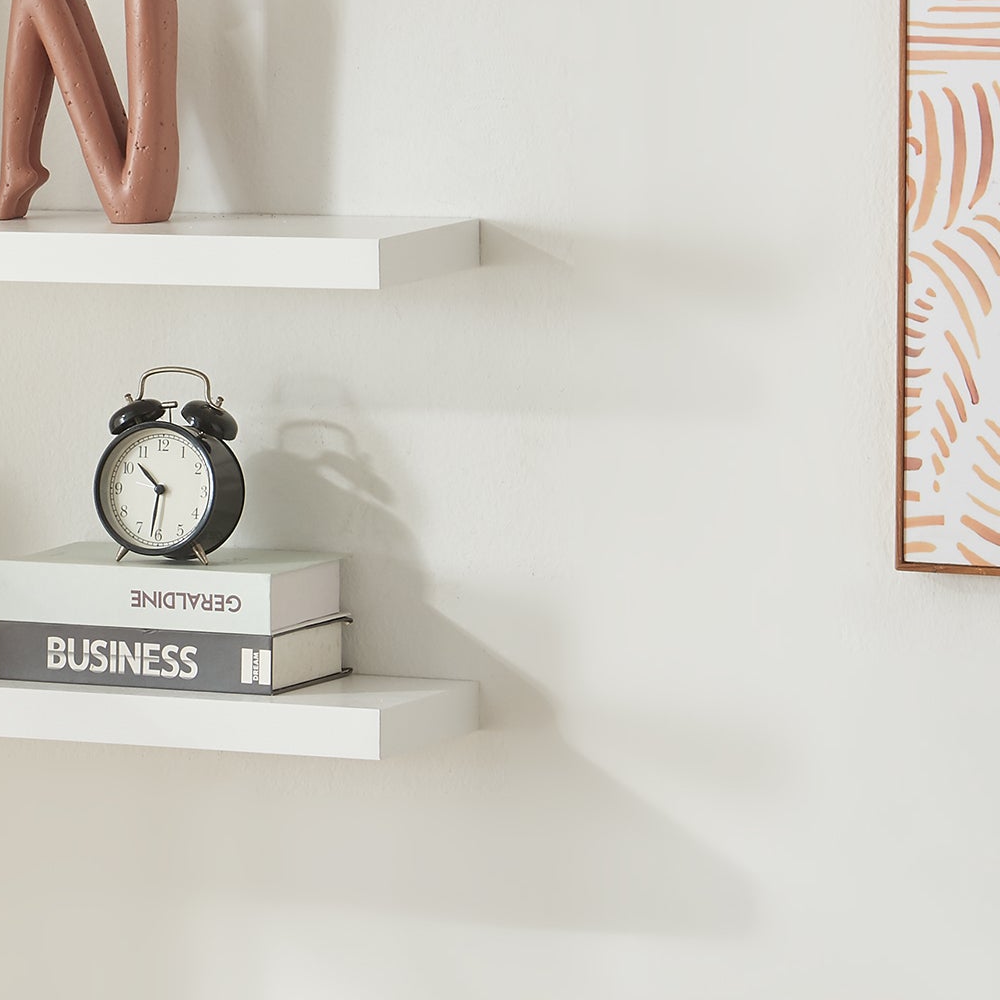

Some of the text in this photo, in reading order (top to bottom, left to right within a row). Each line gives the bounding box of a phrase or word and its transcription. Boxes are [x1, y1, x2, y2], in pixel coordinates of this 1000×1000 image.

[158, 439, 169, 451] 12
[139, 446, 148, 458] 11
[181, 446, 185, 458] 1
[123, 462, 134, 474] 10
[194, 462, 202, 475] 2
[115, 482, 123, 495] 9
[200, 486, 207, 498] 3
[120, 505, 128, 517] 8
[191, 507, 199, 519] 4
[136, 522, 143, 533] 7
[176, 524, 184, 537] 5
[154, 529, 162, 541] 6
[131, 590, 242, 613] GERALDINE
[47, 636, 198, 680] BUSINESS
